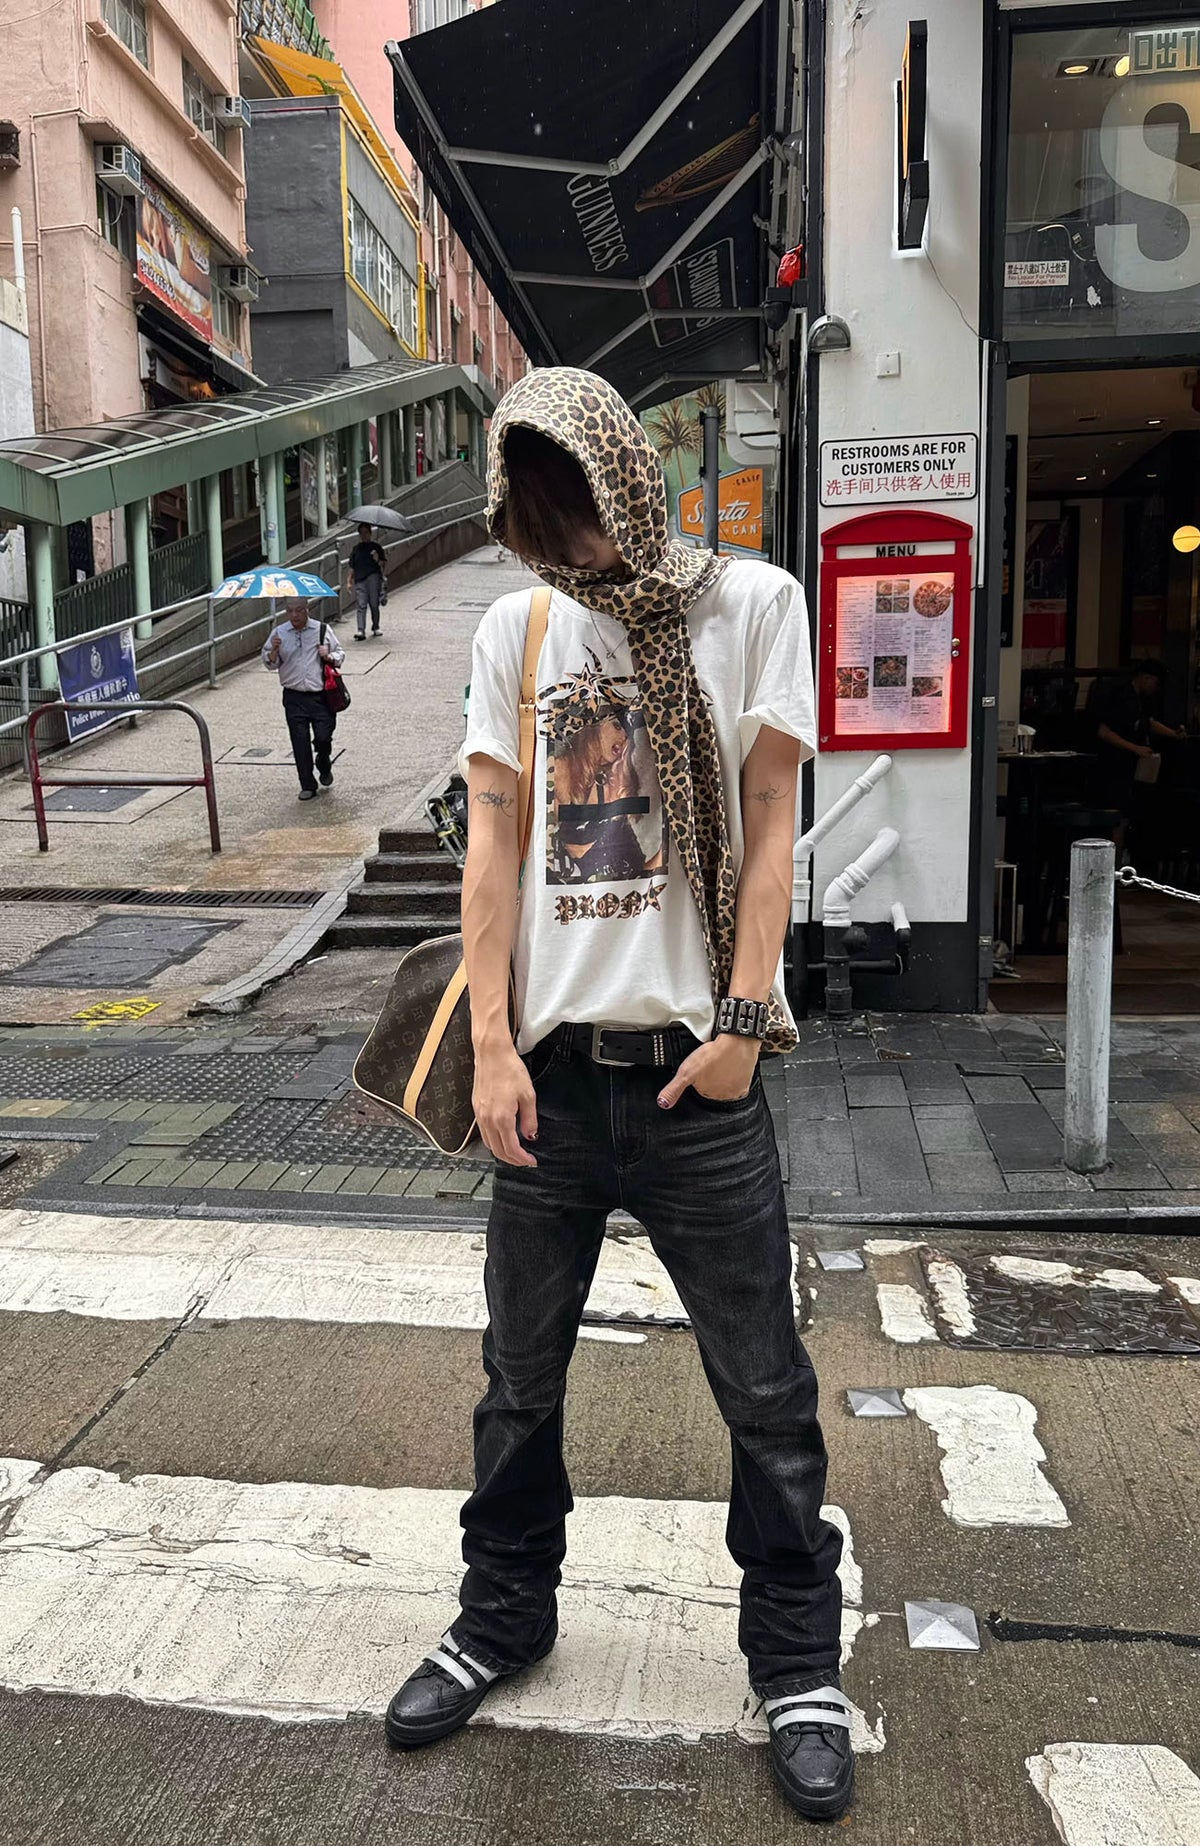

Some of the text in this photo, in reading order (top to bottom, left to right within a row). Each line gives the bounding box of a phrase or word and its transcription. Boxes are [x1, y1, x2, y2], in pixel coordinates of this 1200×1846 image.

[567, 173, 628, 272] GUINNESS
[687, 249, 722, 328] STAUNTOS
[832, 441, 966, 460] RESTROOMS ARE FOR
[841, 458, 956, 476] CUSTOMERS ONLY
[826, 472, 971, 497] 洗手间只供客人使用
[687, 500, 751, 524] Snta
[875, 544, 916, 558] MENU
